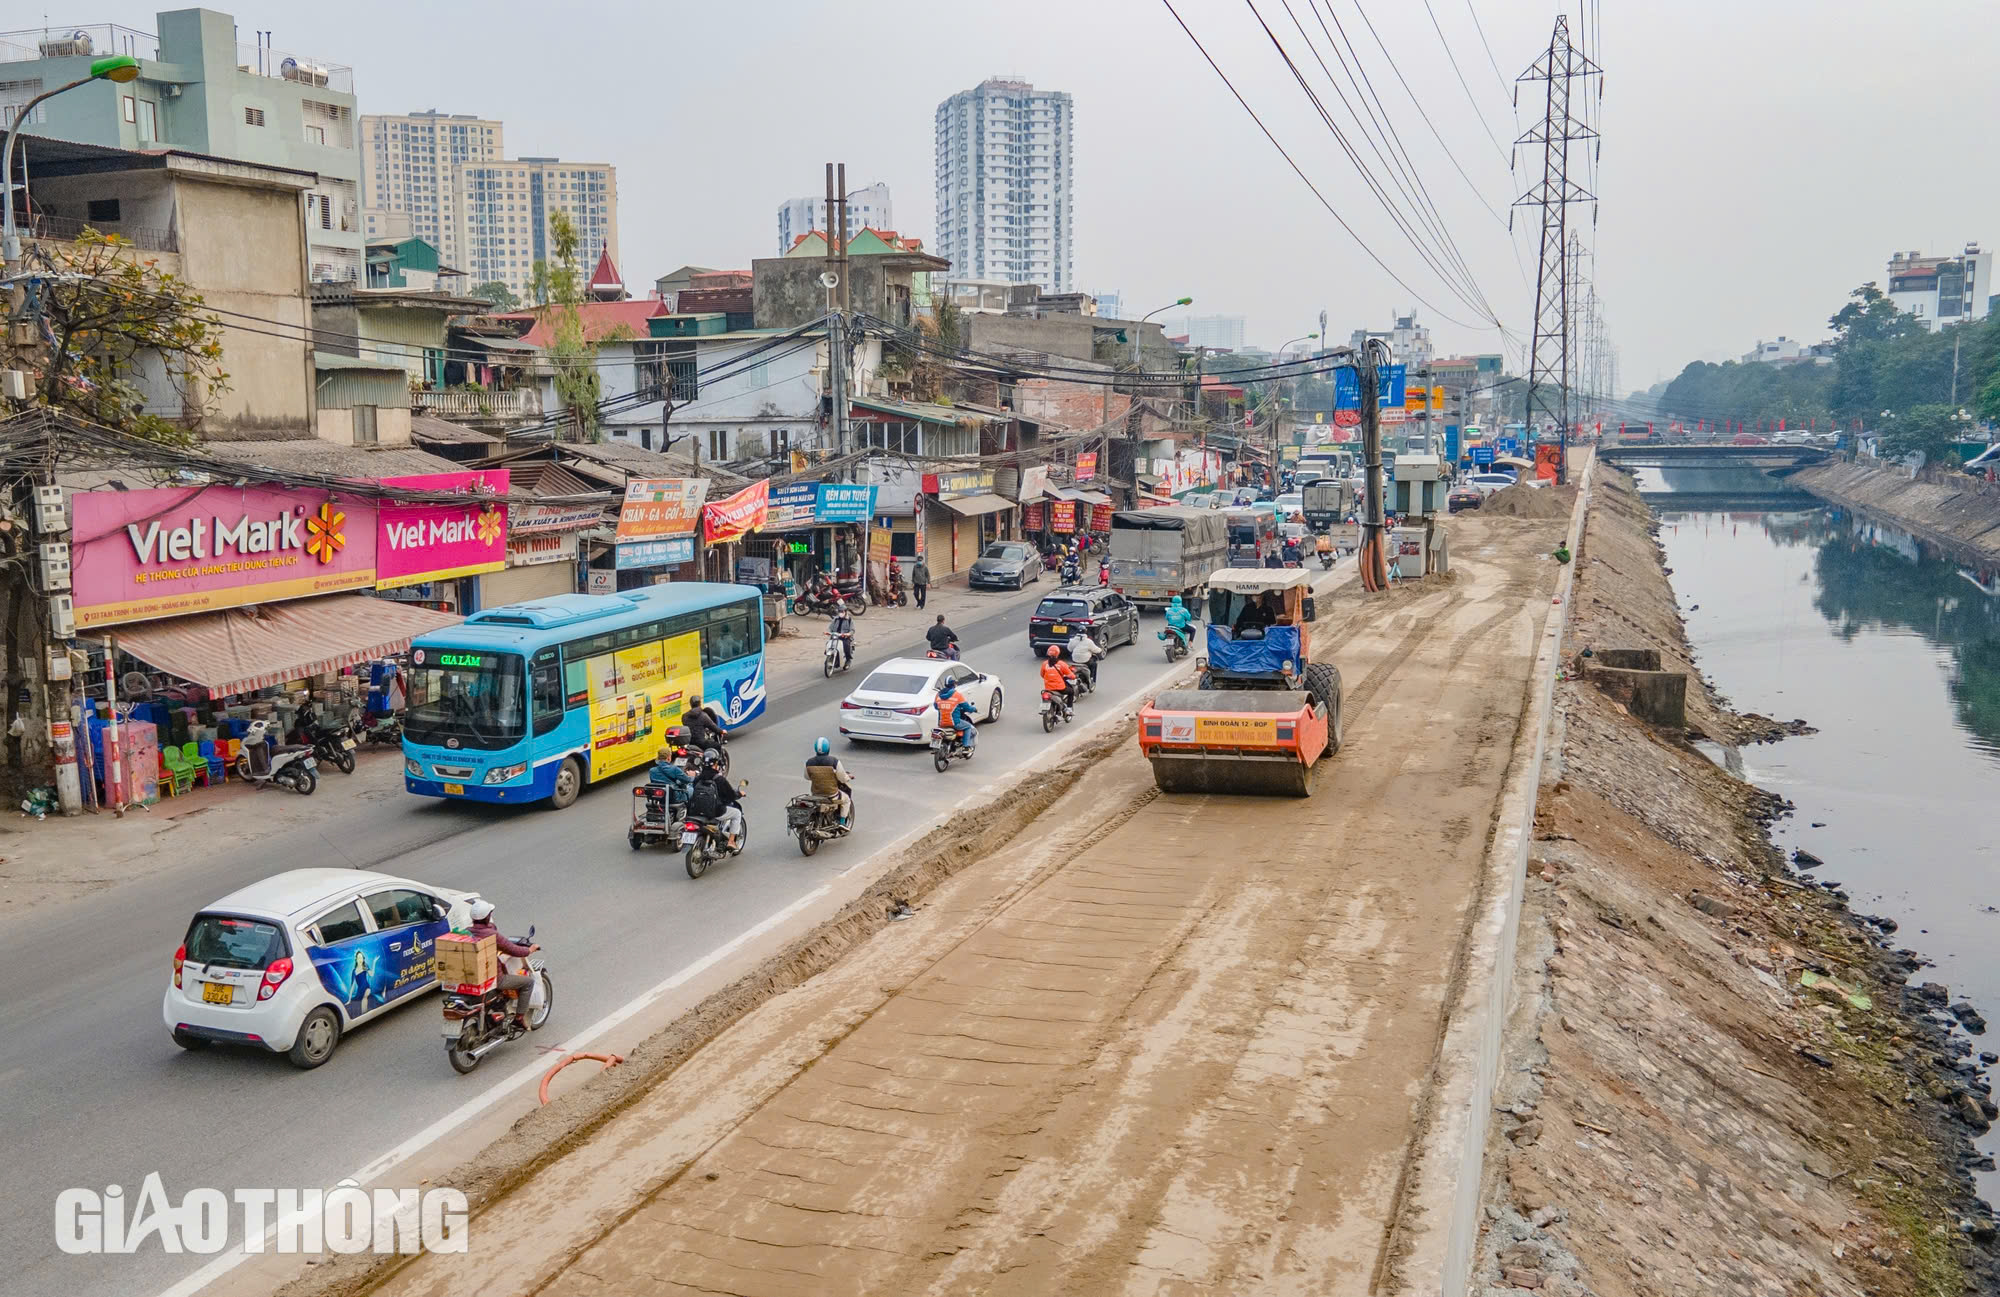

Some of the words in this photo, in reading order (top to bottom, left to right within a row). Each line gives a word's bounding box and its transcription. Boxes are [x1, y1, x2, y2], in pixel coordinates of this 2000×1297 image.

[840, 490, 851, 501] KIM
[852, 488, 870, 501] TUYẾ
[649, 508, 660, 520] GA
[665, 501, 679, 520] GỐI
[560, 515, 576, 523] KINH
[128, 518, 206, 564] Viet
[213, 511, 302, 556] Mark
[386, 519, 426, 551] Viet
[429, 514, 476, 546] Mark
[532, 537, 560, 552] MINH
[285, 554, 297, 567] ÍCH
[415, 651, 424, 663] 42
[441, 654, 457, 666] GIA
[458, 654, 480, 666] LÂM
